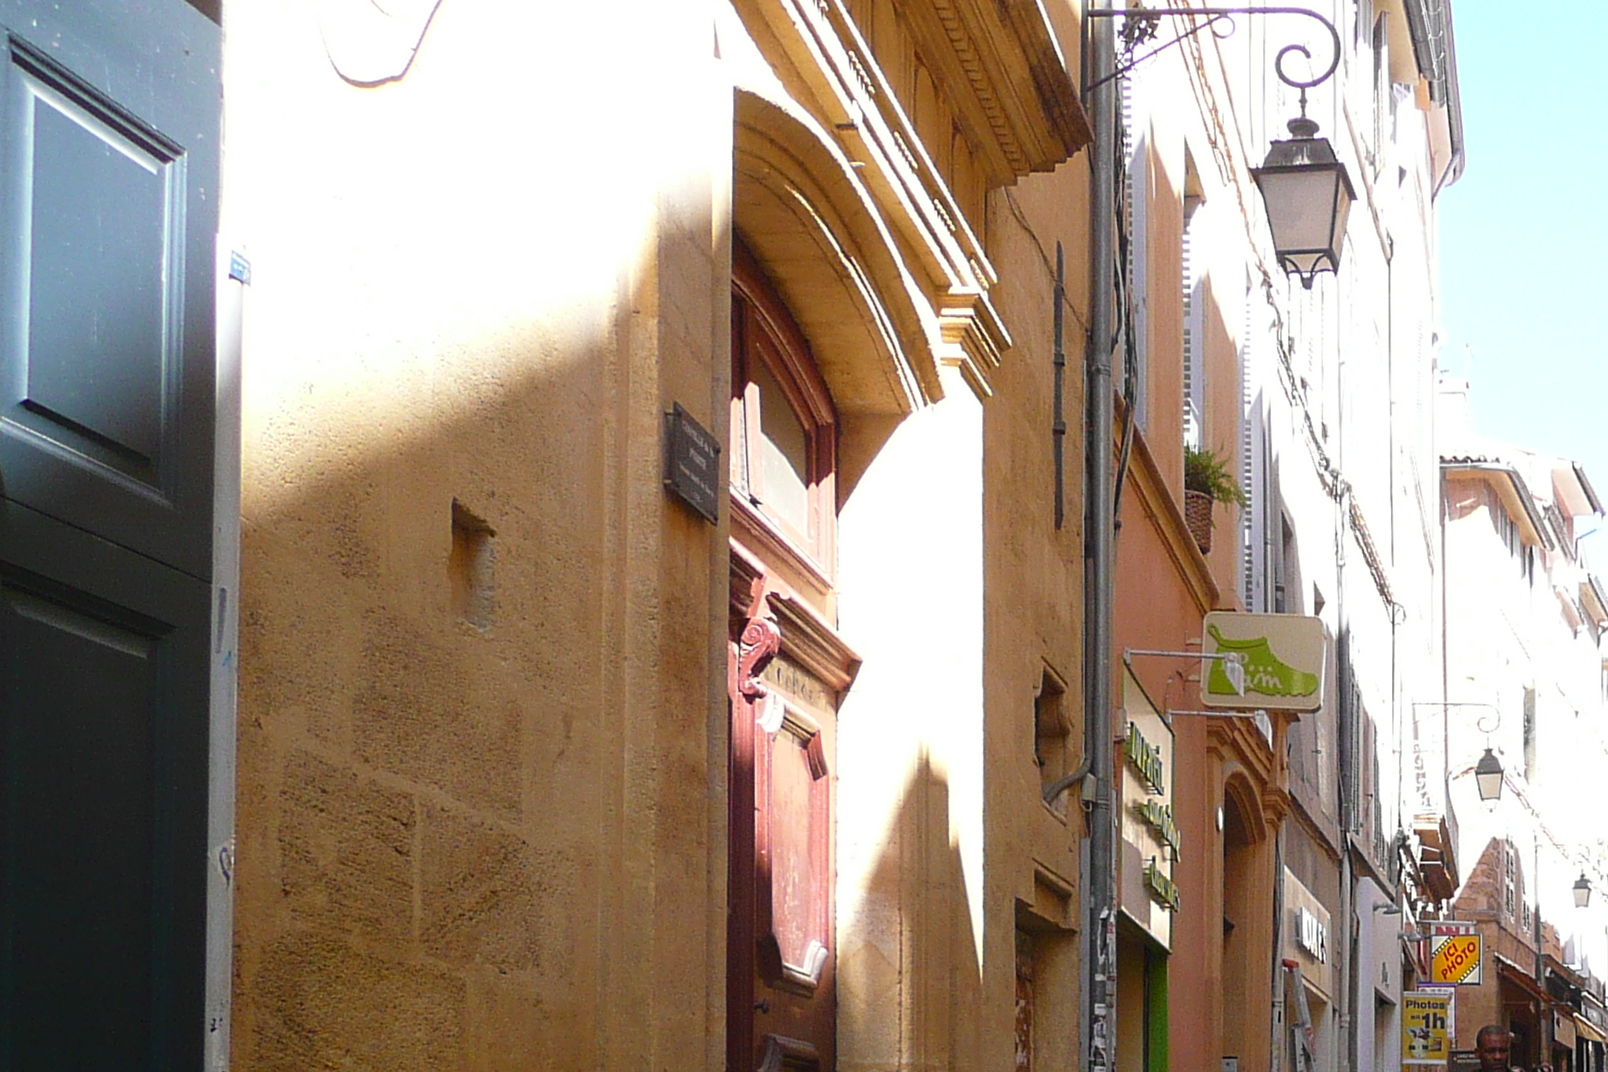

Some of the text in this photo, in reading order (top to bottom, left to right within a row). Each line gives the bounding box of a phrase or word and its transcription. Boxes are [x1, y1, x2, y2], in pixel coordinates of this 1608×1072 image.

[1440, 941, 1477, 980] PHOTO
[1443, 942, 1459, 961] ICI
[1405, 1000, 1446, 1010] Photos
[1422, 1012, 1445, 1030] 1h
